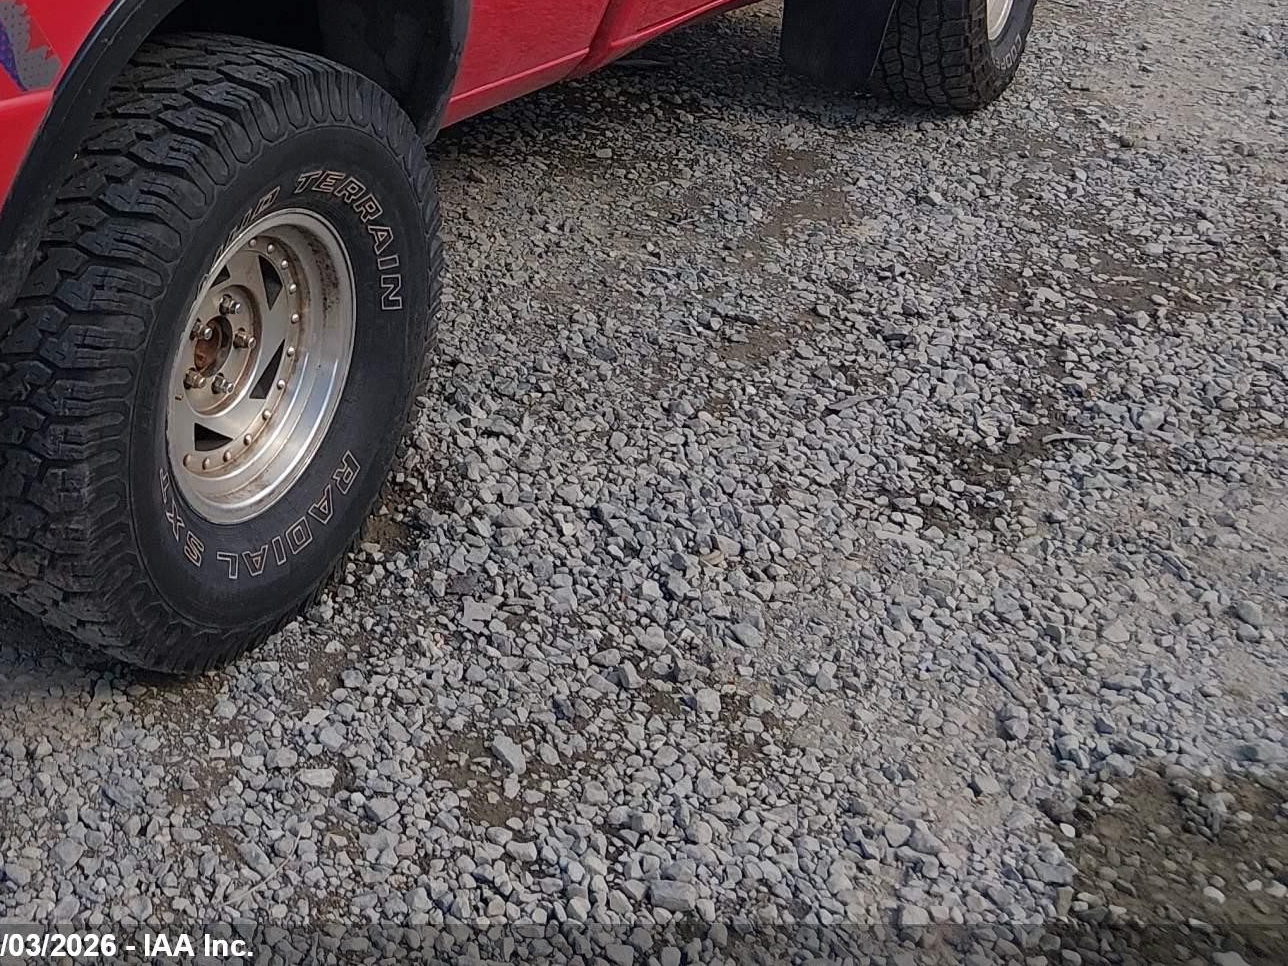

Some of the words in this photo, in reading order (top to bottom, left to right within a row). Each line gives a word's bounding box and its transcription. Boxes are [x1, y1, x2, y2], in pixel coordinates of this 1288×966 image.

[294, 170, 403, 310] TERRAIN
[160, 468, 205, 568] SXT
[217, 450, 361, 579] RADIAL
